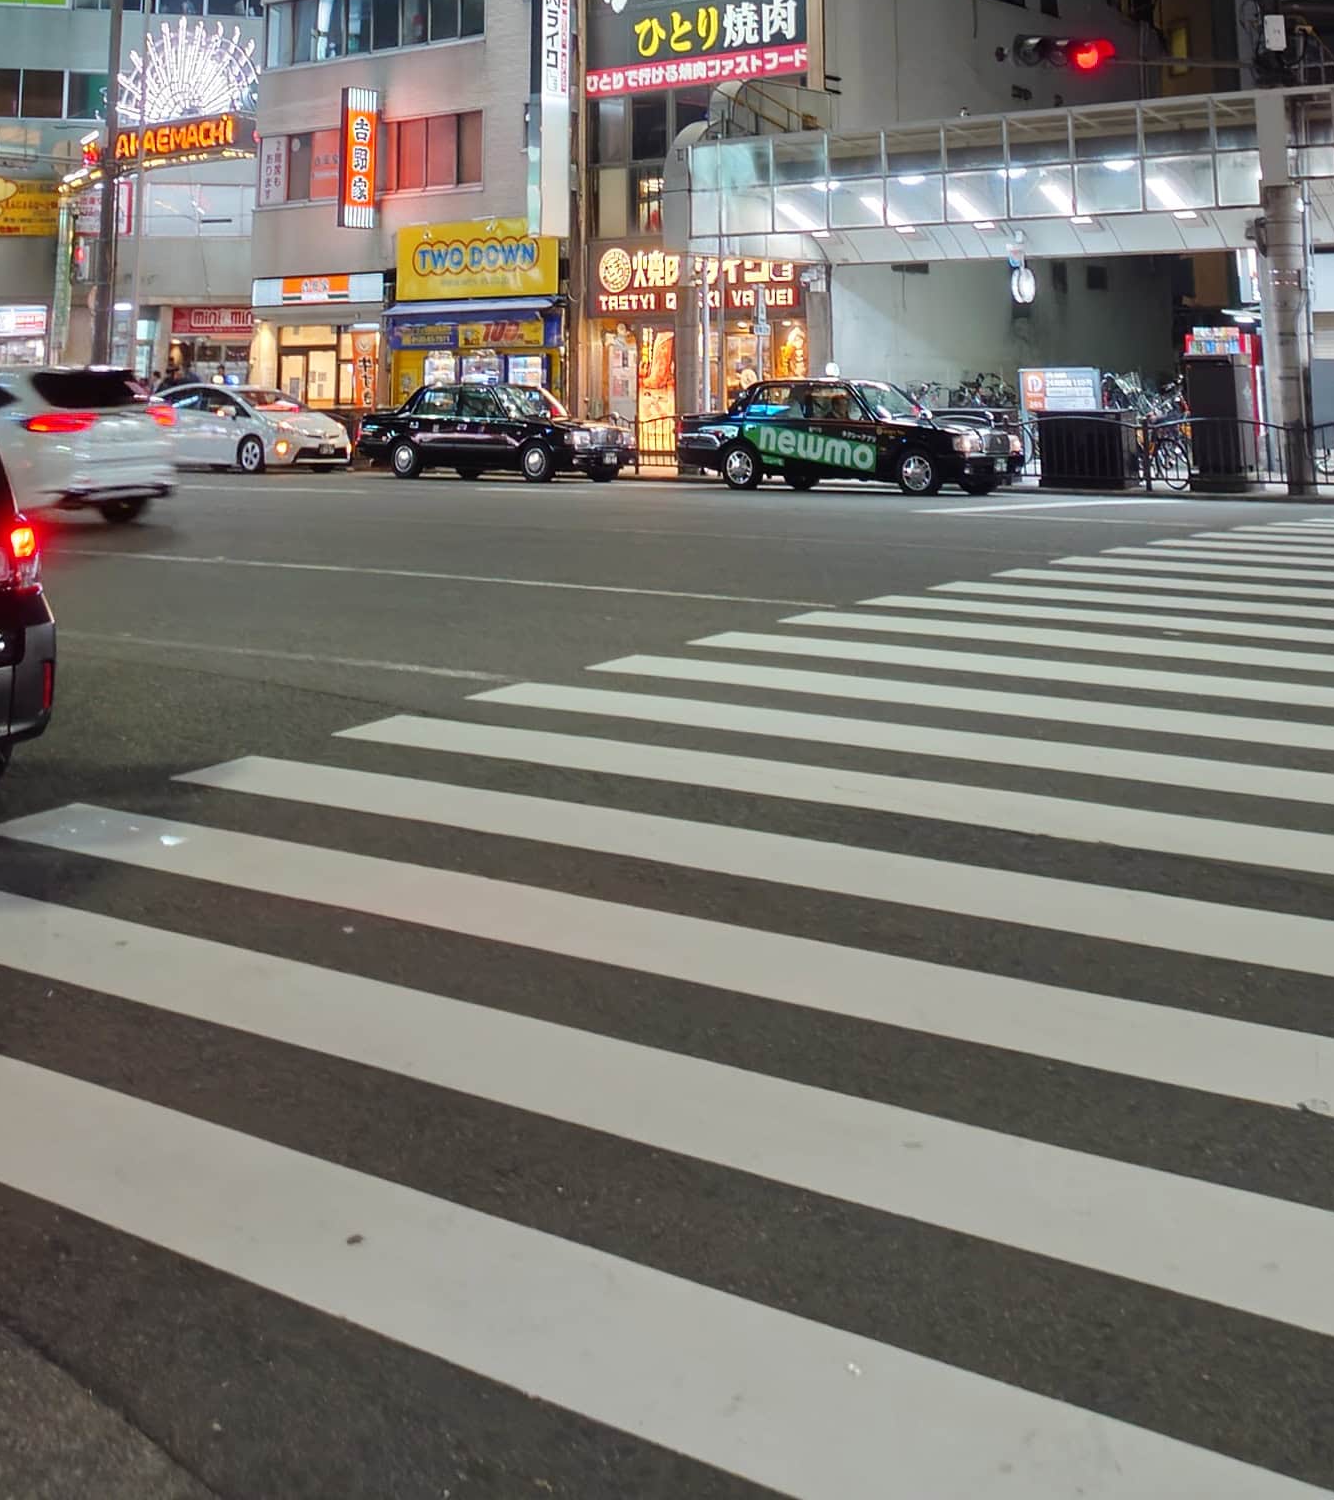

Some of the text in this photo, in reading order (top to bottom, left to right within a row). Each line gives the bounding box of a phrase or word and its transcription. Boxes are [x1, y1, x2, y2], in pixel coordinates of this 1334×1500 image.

[351, 116, 370, 204] 吉野家
[418, 243, 535, 269] TWO DOWN
[731, 288, 793, 308] VAUE!
[758, 425, 875, 470] newmo
